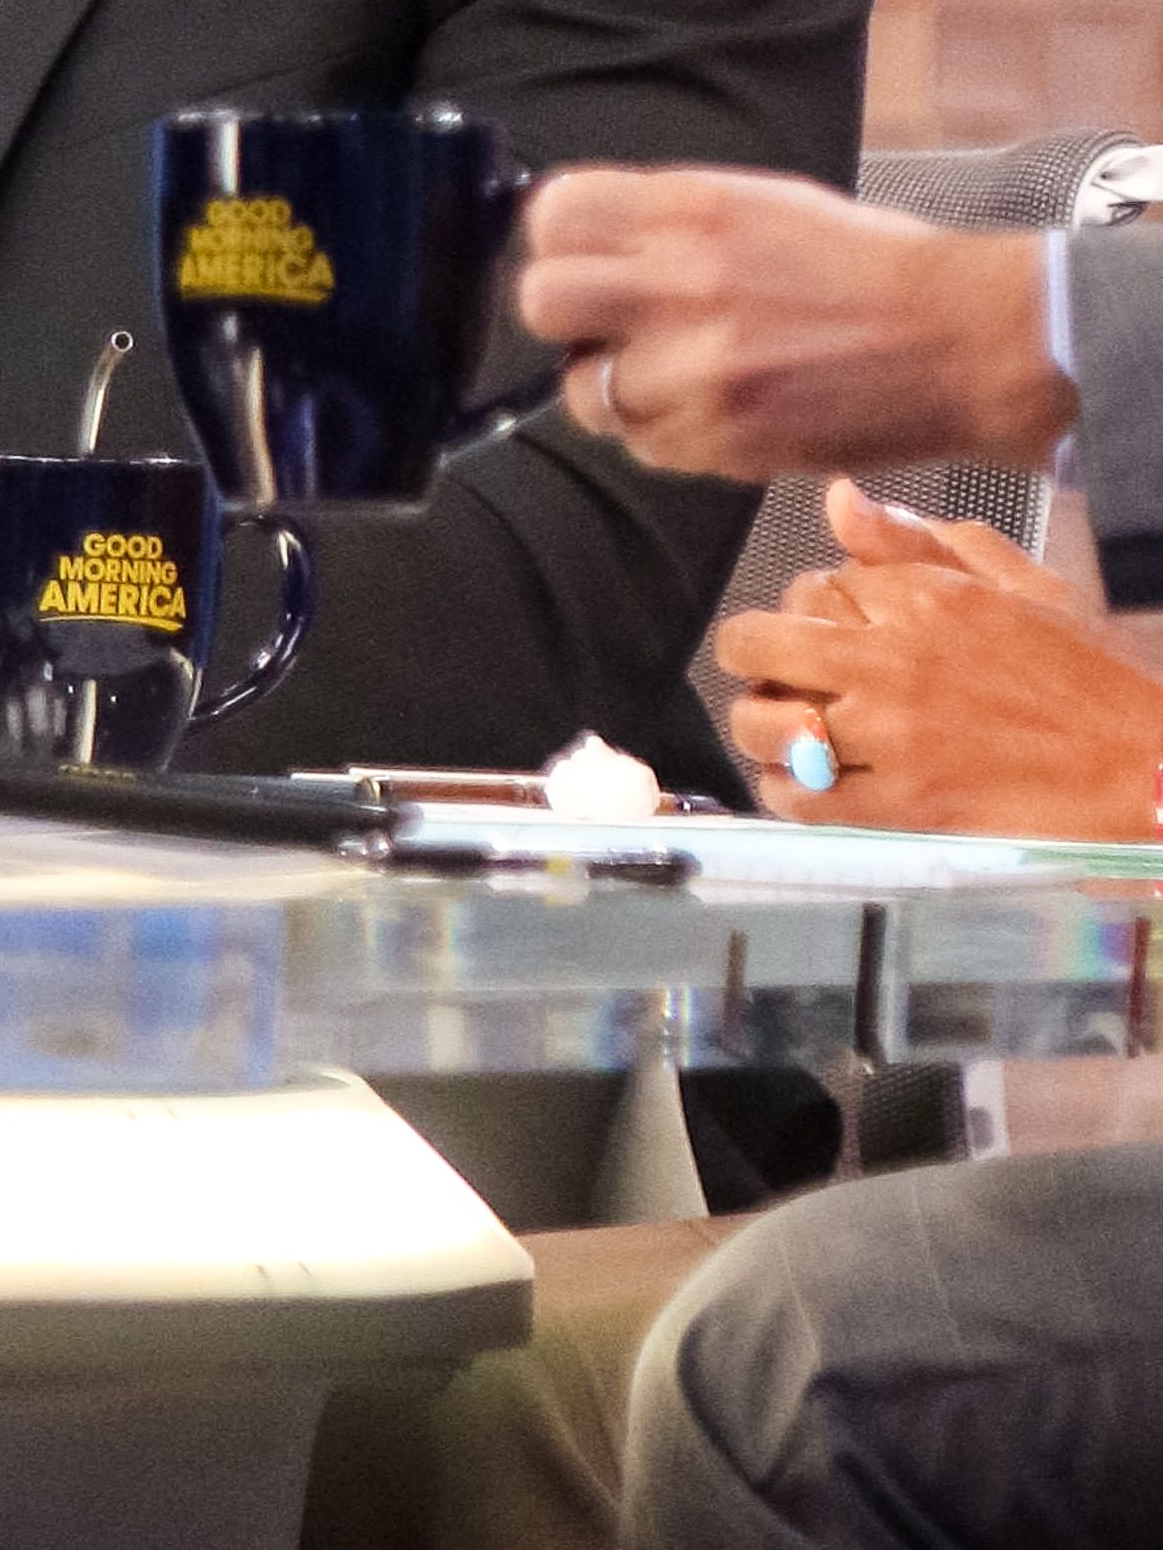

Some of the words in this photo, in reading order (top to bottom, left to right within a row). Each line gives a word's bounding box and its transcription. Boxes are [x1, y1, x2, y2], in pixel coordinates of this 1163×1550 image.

[180, 251, 335, 293] AMERICA
[83, 532, 164, 560] GOOD
[59, 555, 179, 586] MORNING
[39, 580, 187, 619] AMERICA
